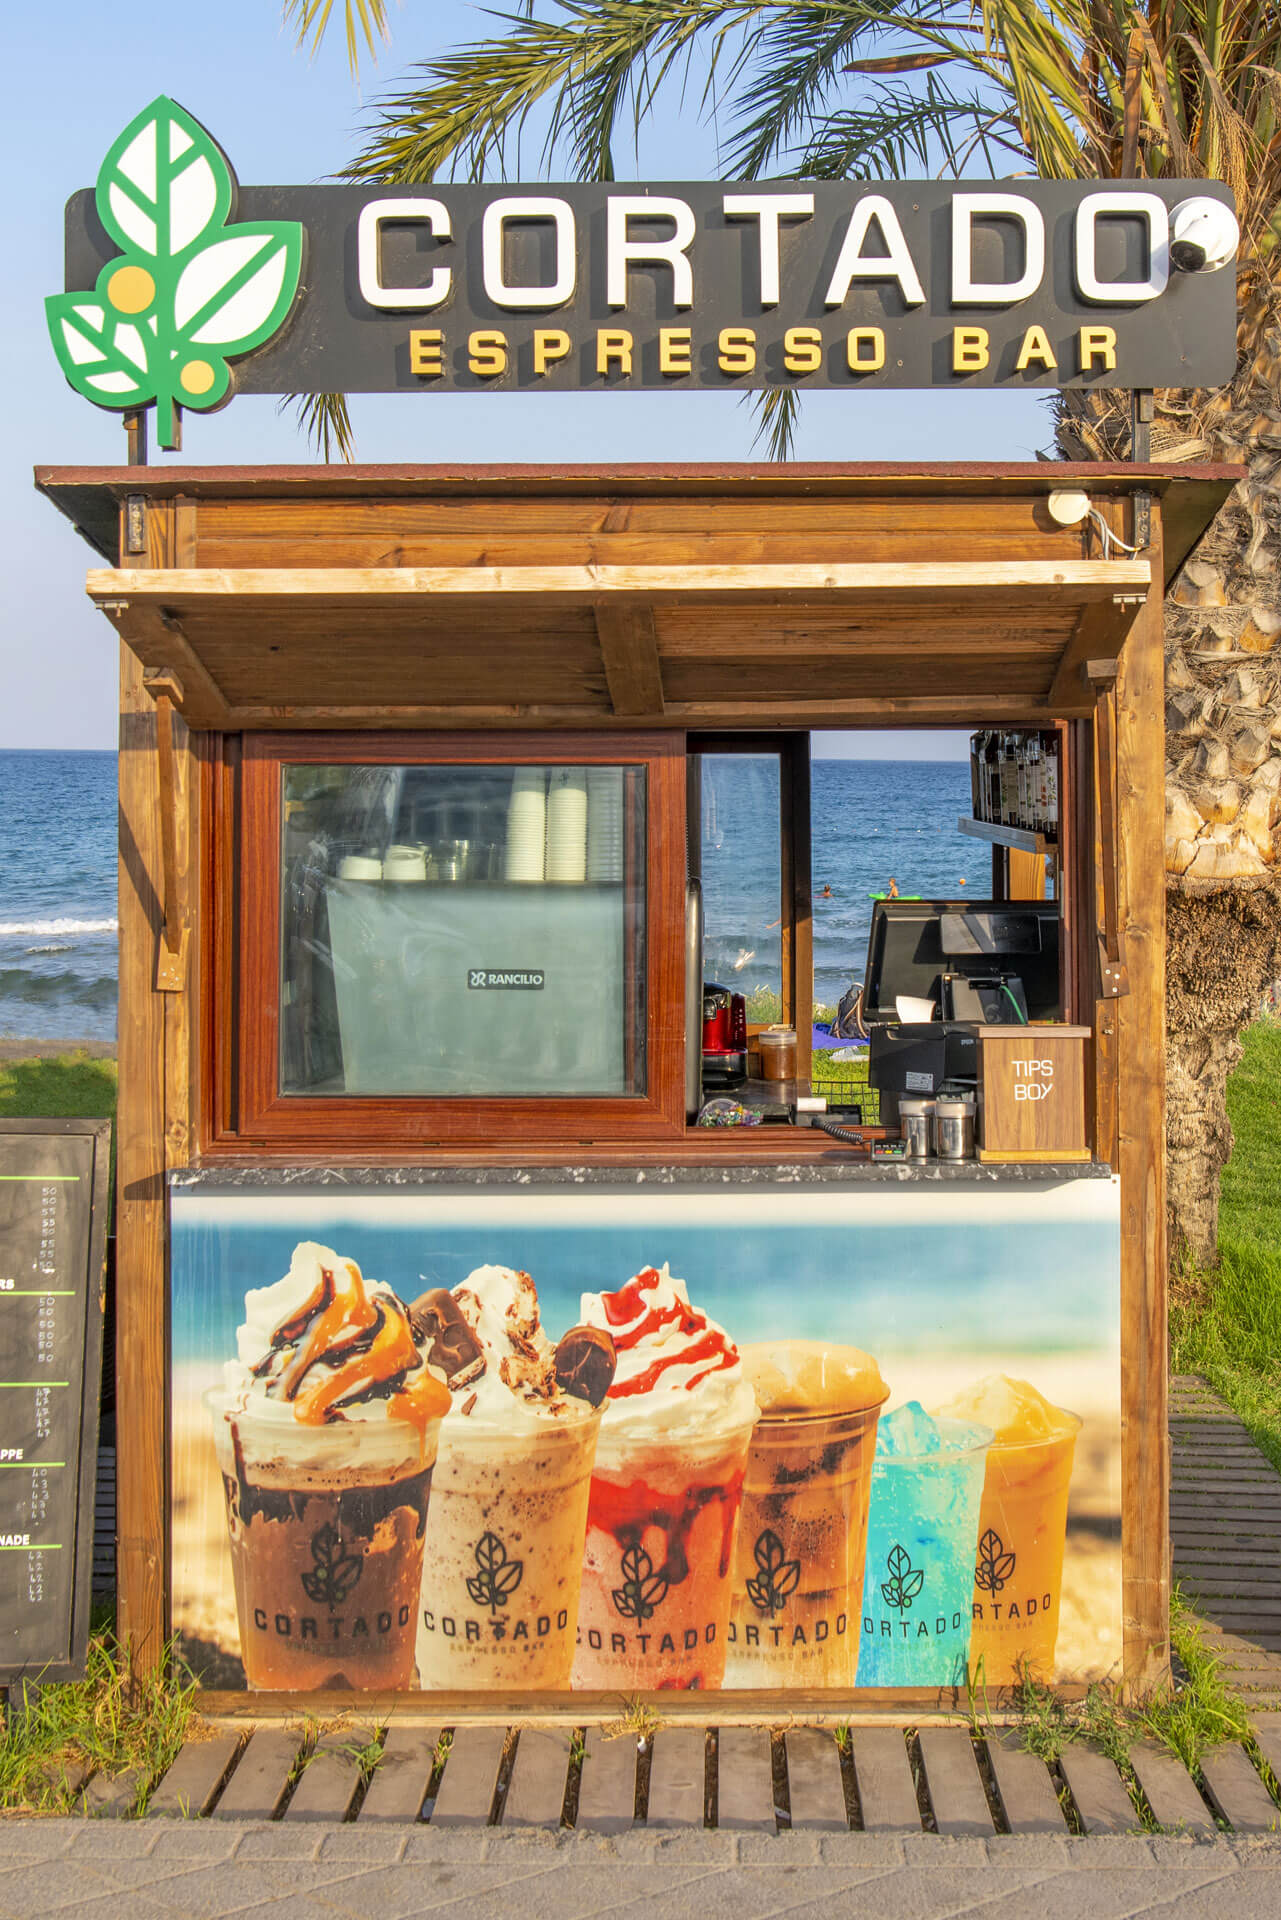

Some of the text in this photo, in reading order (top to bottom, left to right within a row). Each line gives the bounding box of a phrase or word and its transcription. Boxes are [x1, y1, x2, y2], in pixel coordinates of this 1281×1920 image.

[358, 191, 1169, 309] CORTADO
[409, 325, 1117, 375] ESPRESSO BAR
[488, 973, 543, 985] RANCILIO
[1011, 1059, 1054, 1077] TIPS
[1014, 1083, 1053, 1101] BOY
[254, 1605, 409, 1639] CORTADO
[424, 1609, 568, 1641] CORTADO
